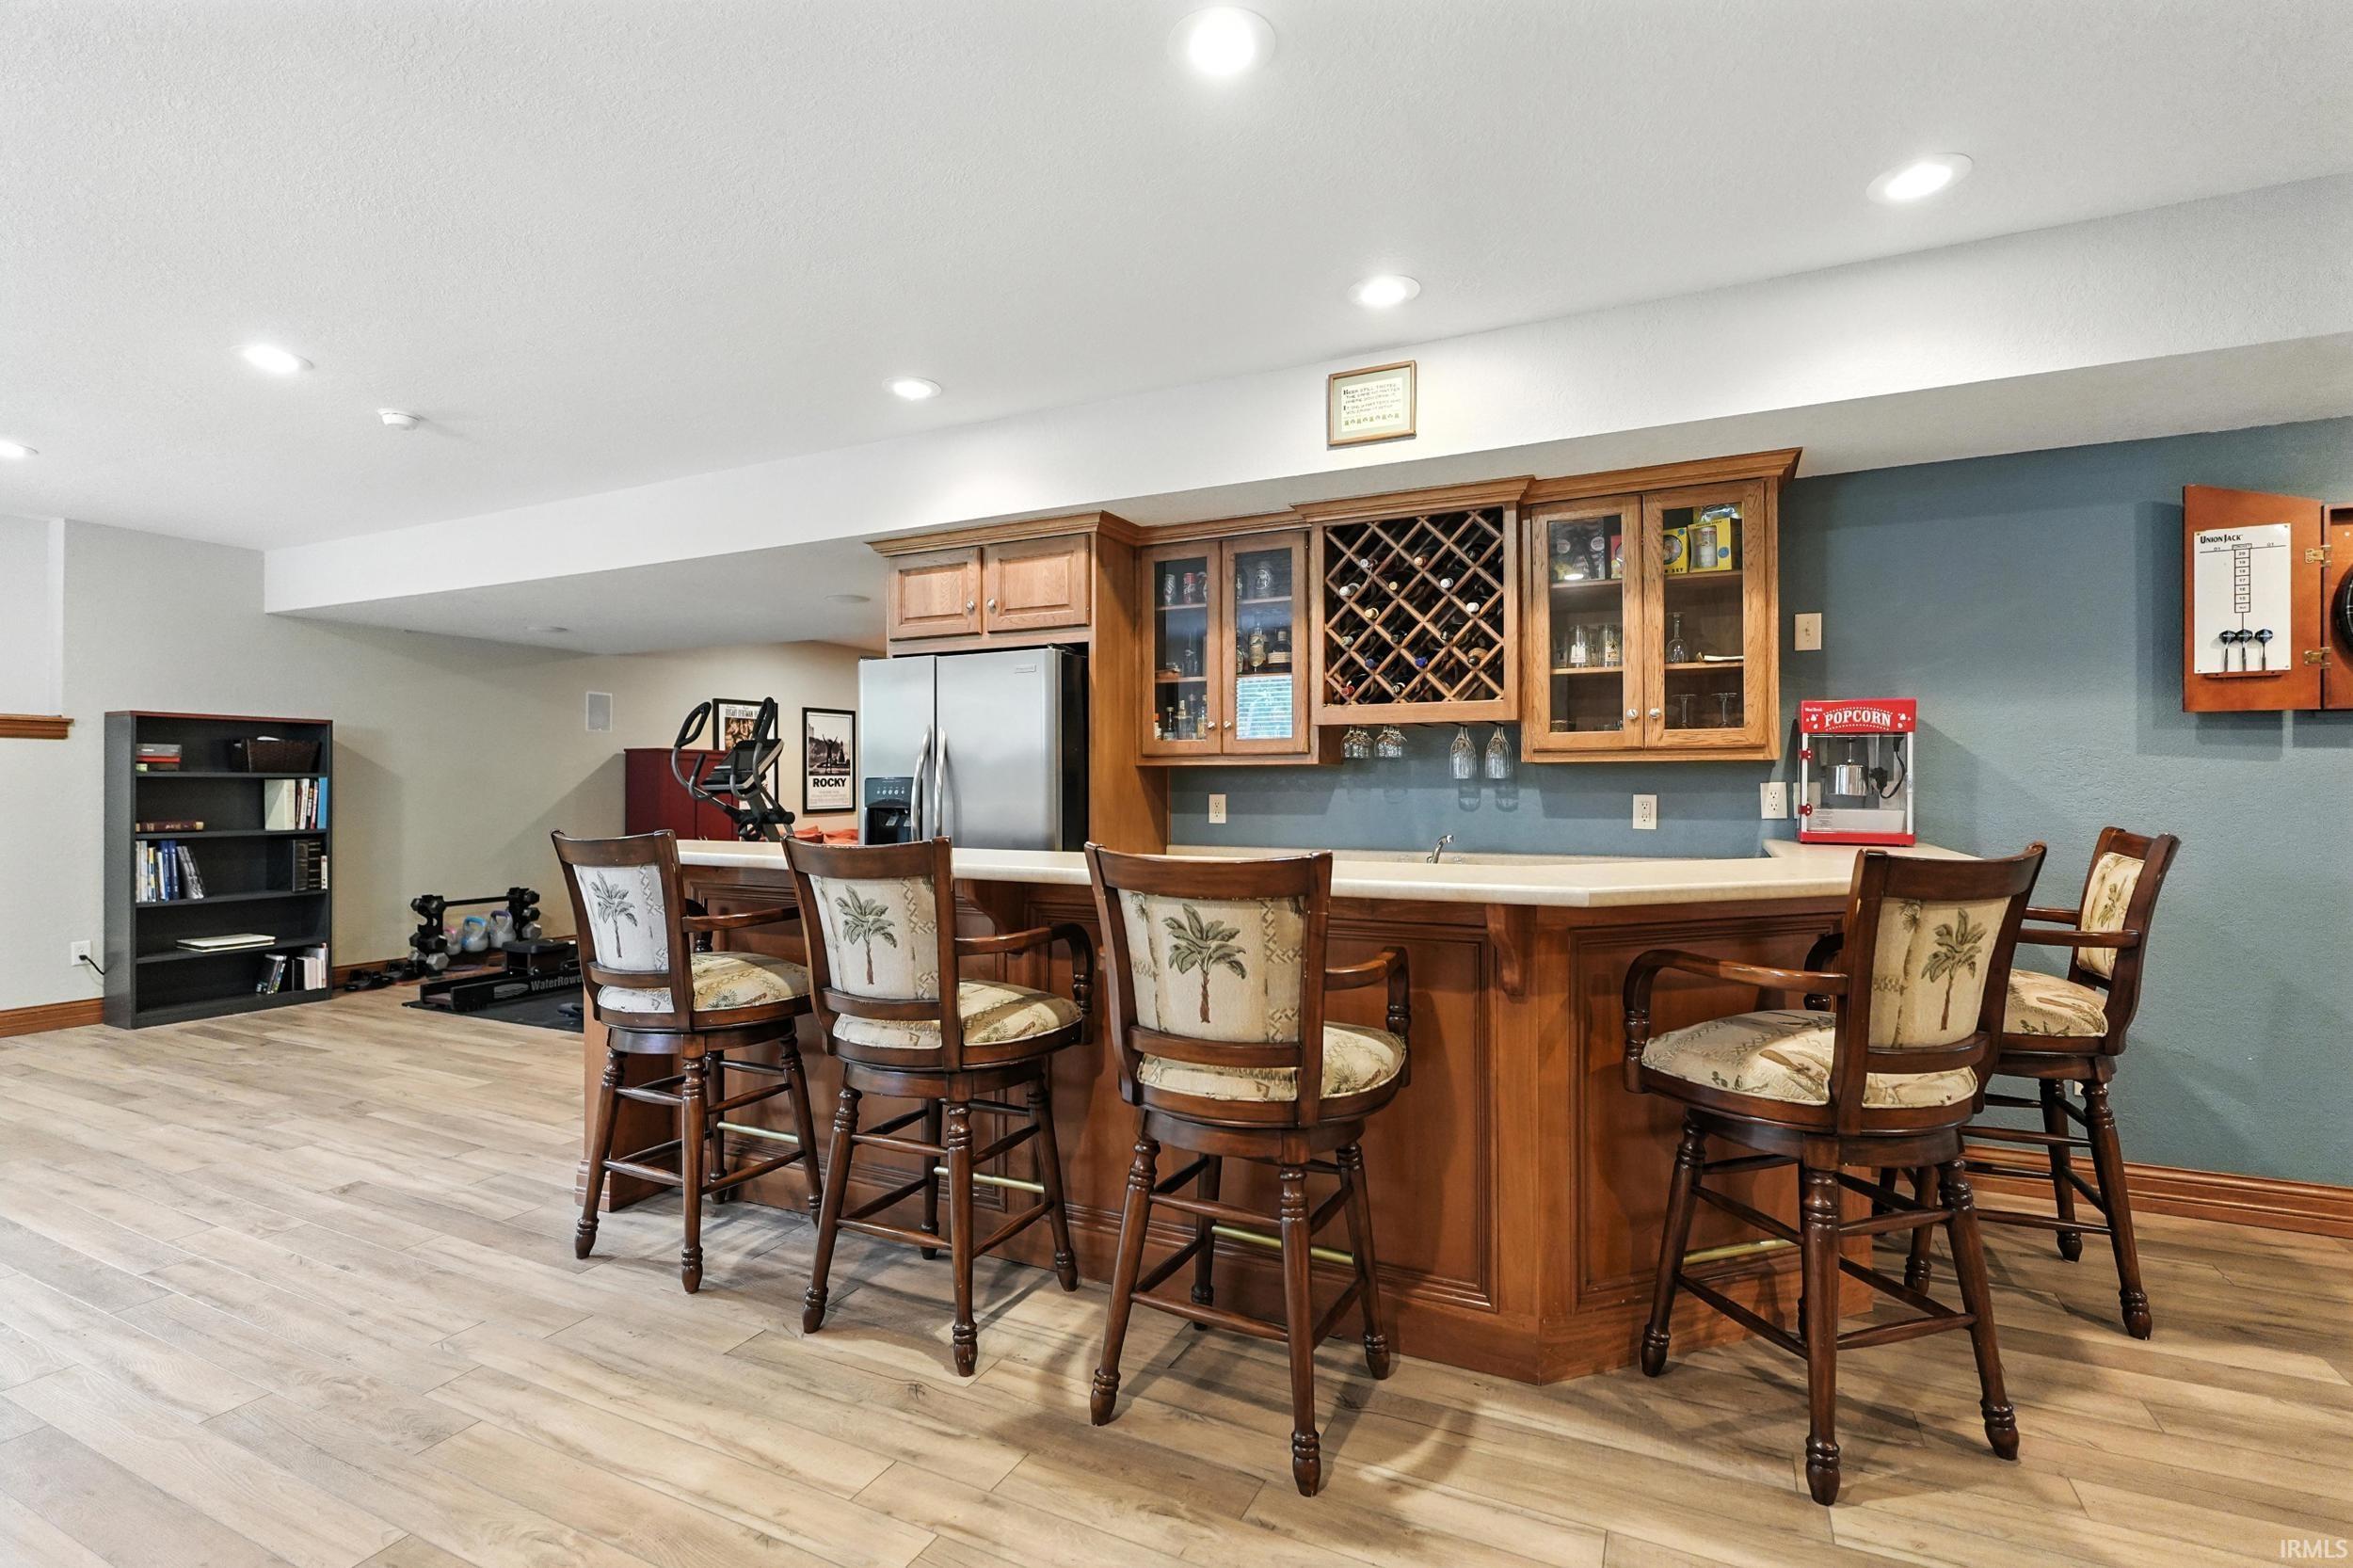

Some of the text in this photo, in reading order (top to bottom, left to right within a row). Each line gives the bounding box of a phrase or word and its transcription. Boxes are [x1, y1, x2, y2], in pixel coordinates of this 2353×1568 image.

[2200, 534, 2241, 544] UNION JACK
[1824, 710, 1892, 728] POPCORN
[812, 777, 847, 788] ROCKY
[530, 974, 582, 991] WaterRowe
